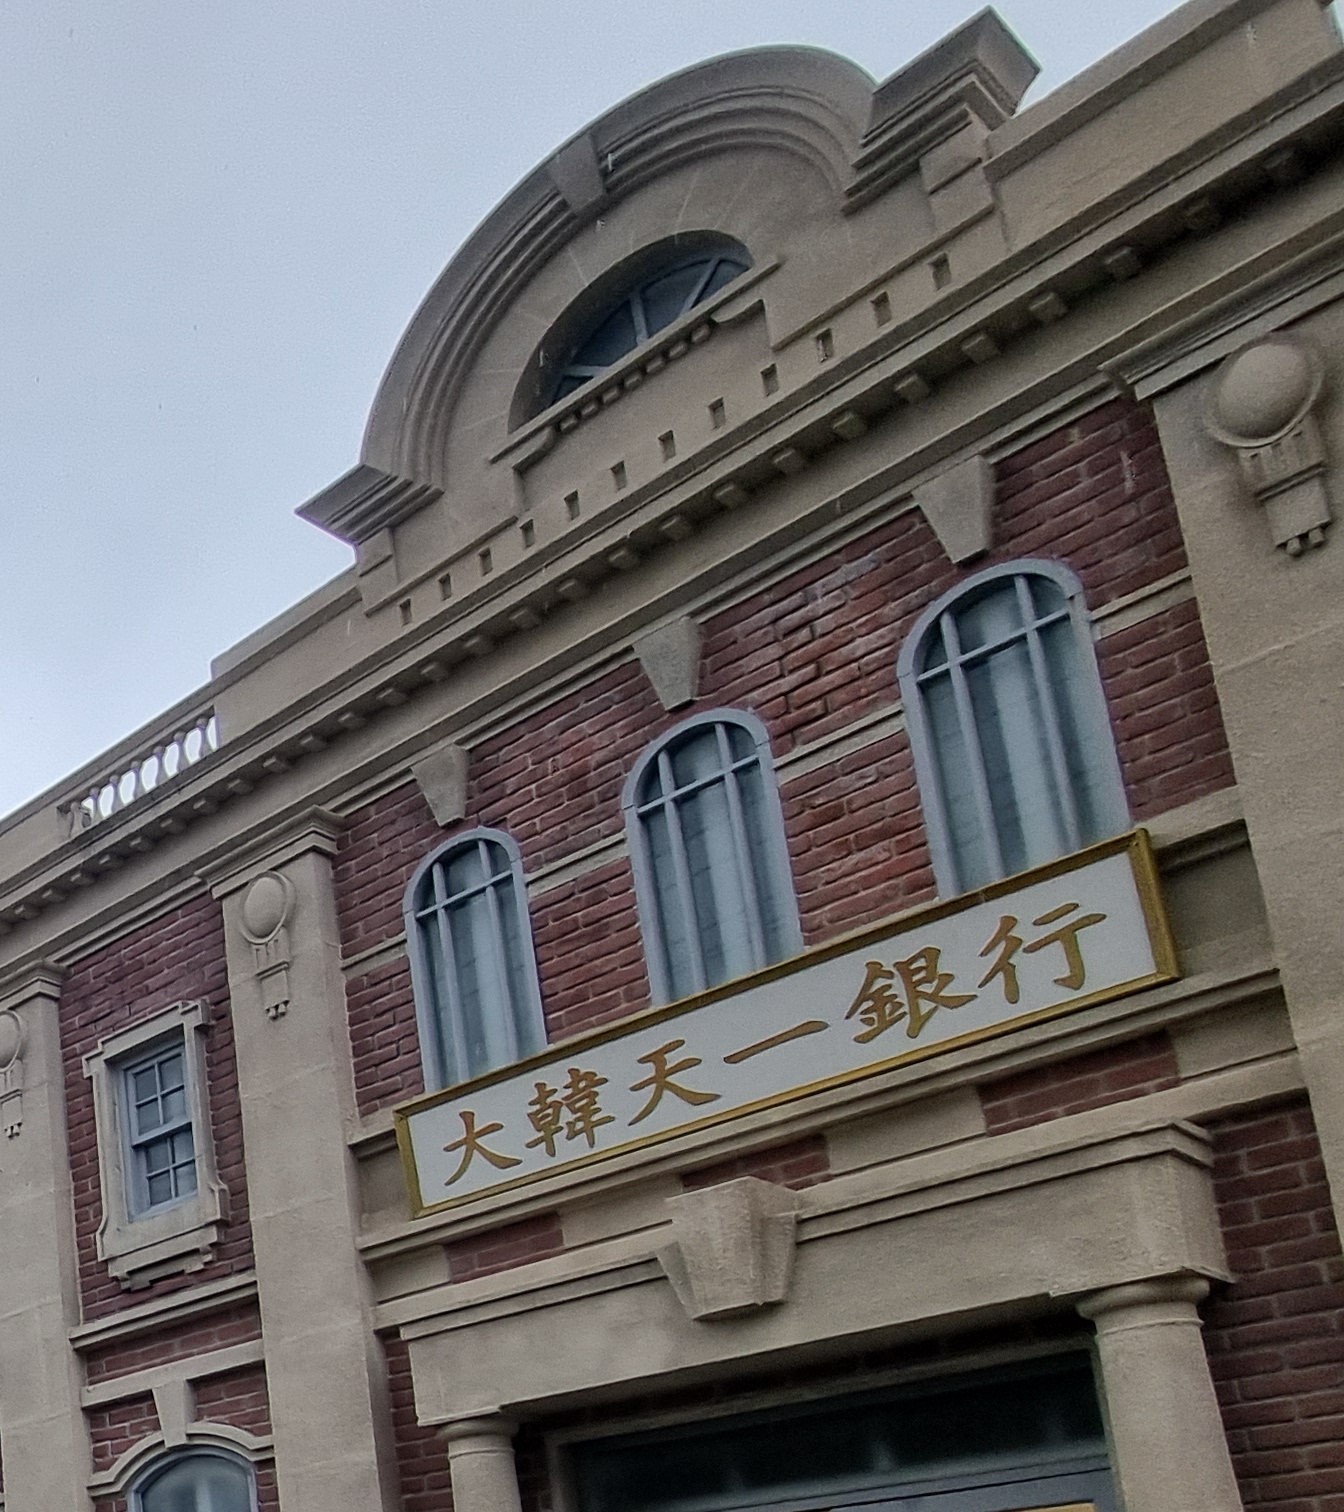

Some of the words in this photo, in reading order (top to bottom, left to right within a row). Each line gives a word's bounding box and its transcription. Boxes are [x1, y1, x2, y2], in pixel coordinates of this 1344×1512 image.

[444, 901, 1108, 1188] 大韓天一銀行
